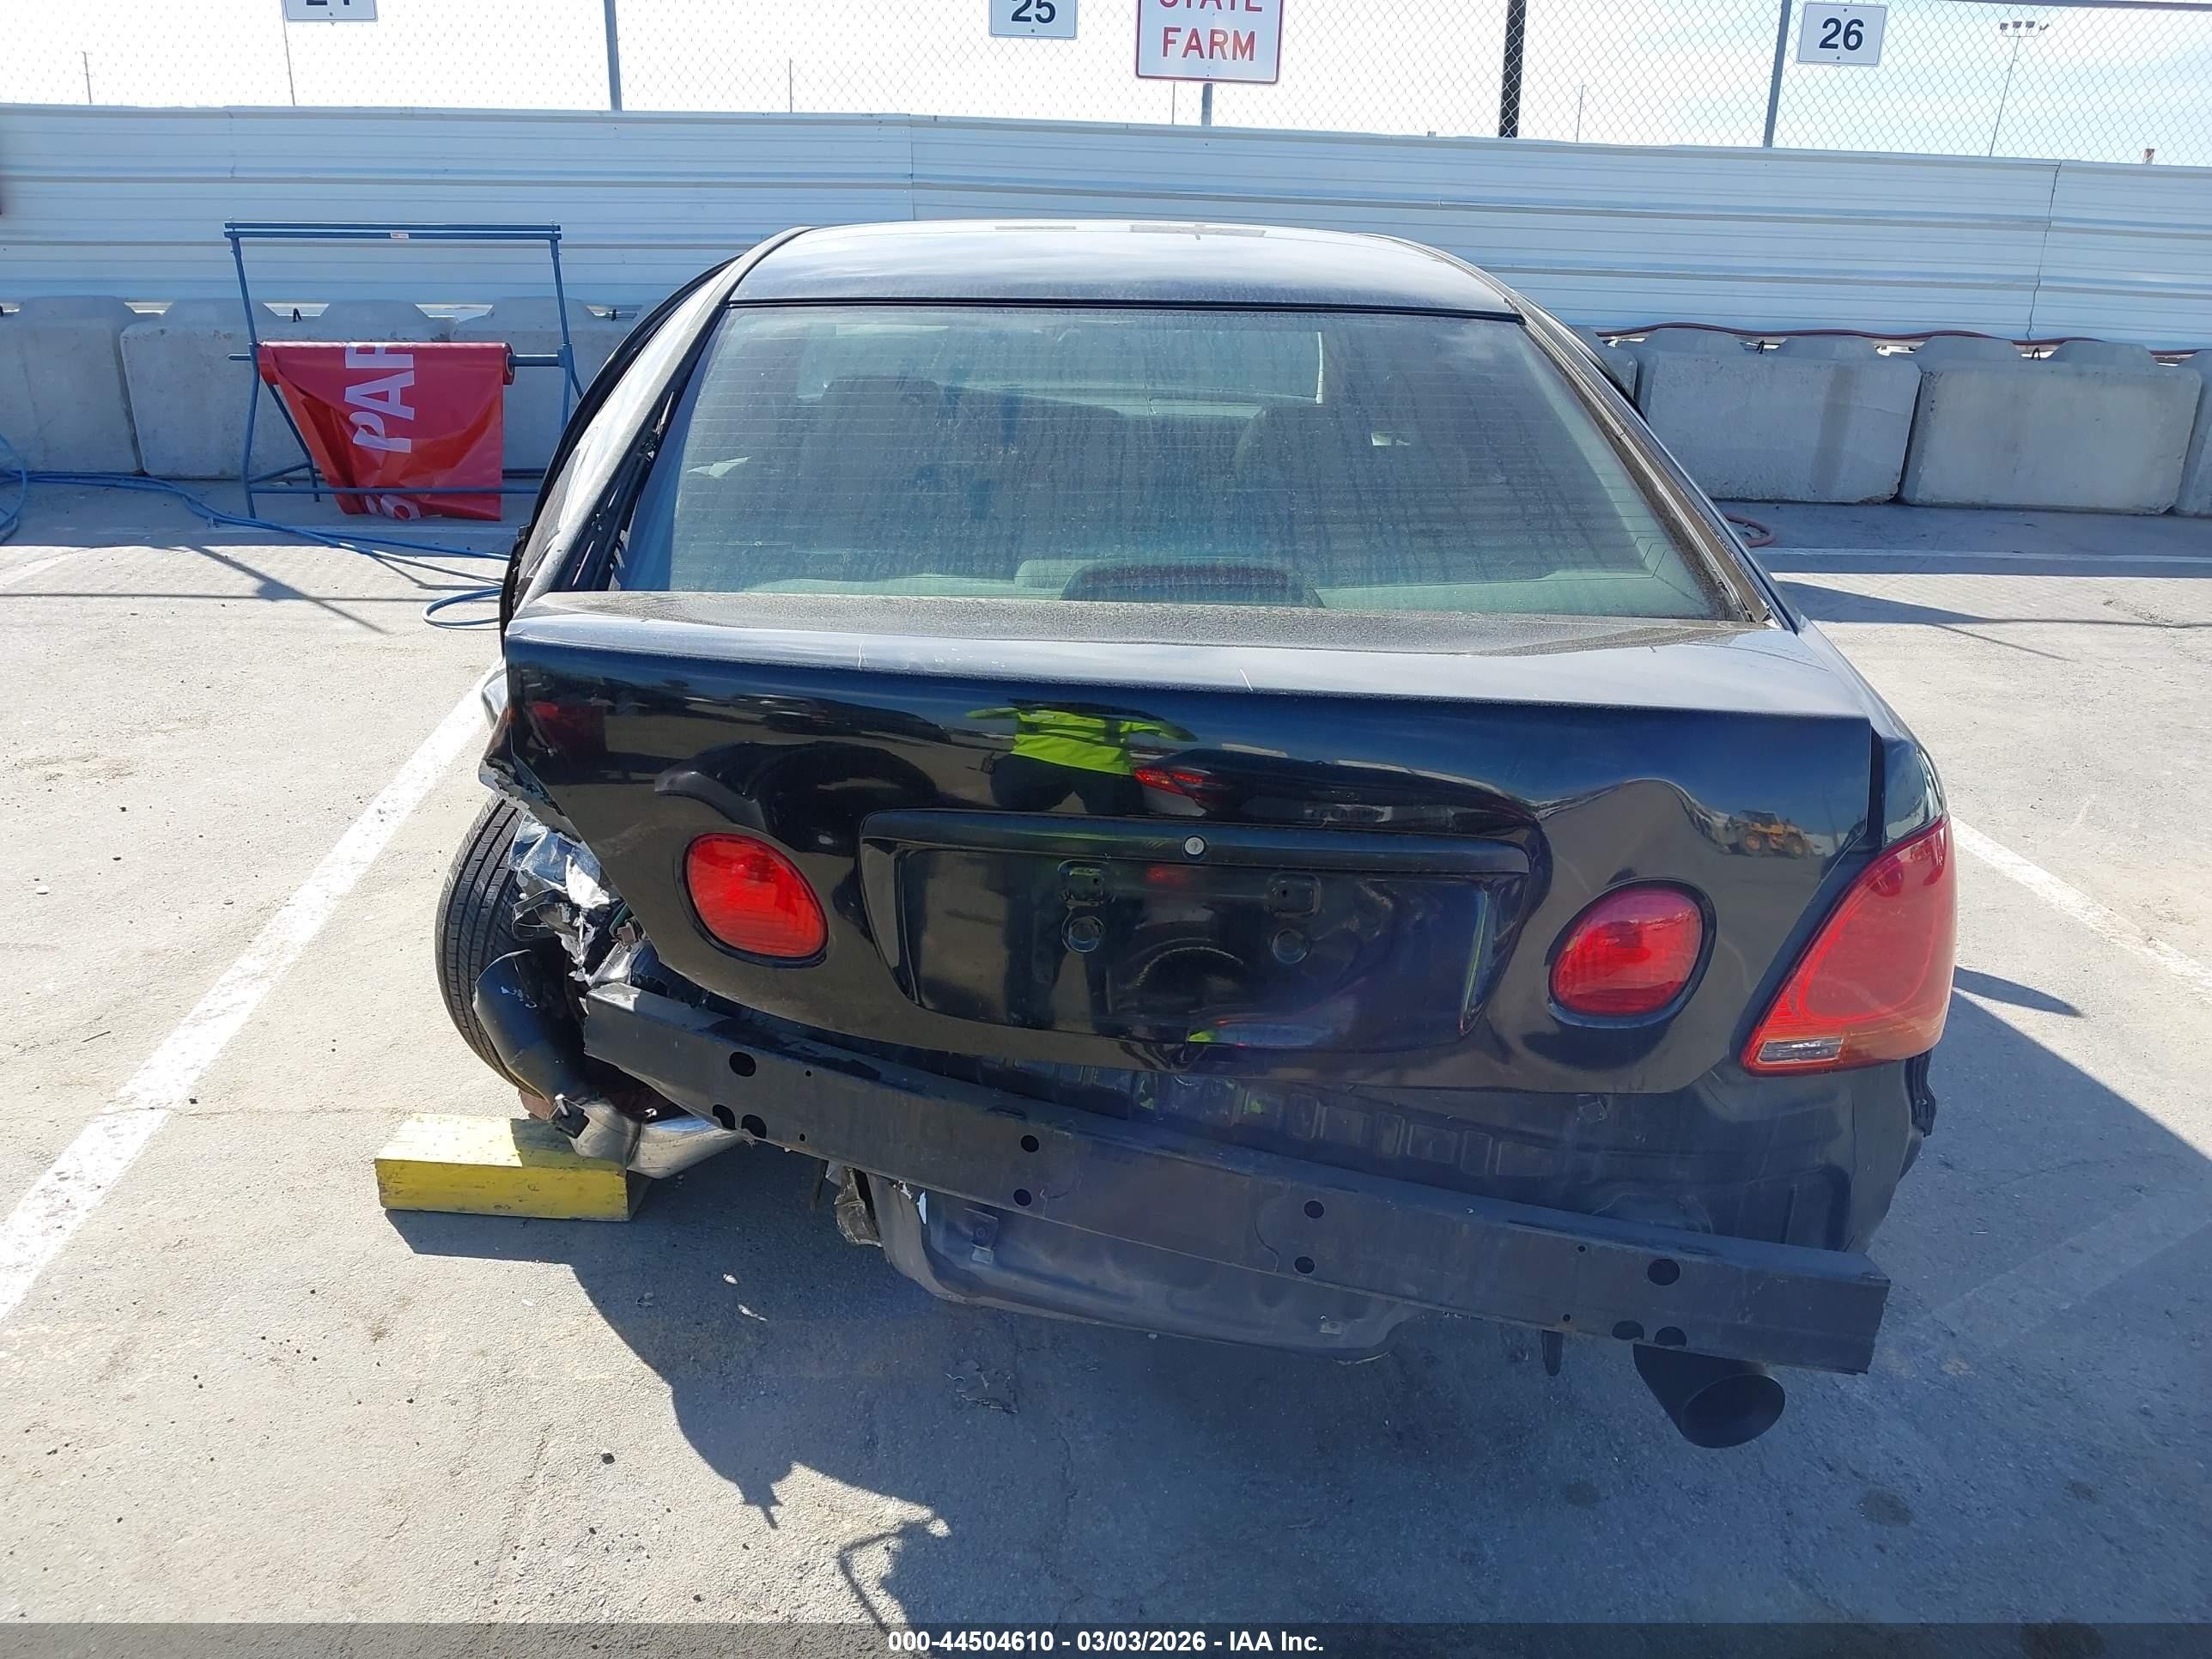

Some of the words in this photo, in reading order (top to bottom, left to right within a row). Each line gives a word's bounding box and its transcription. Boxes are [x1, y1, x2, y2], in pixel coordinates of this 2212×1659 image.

[1011, 0, 1056, 23] 25
[1162, 27, 1255, 61] FARM
[1819, 17, 1864, 51] 26
